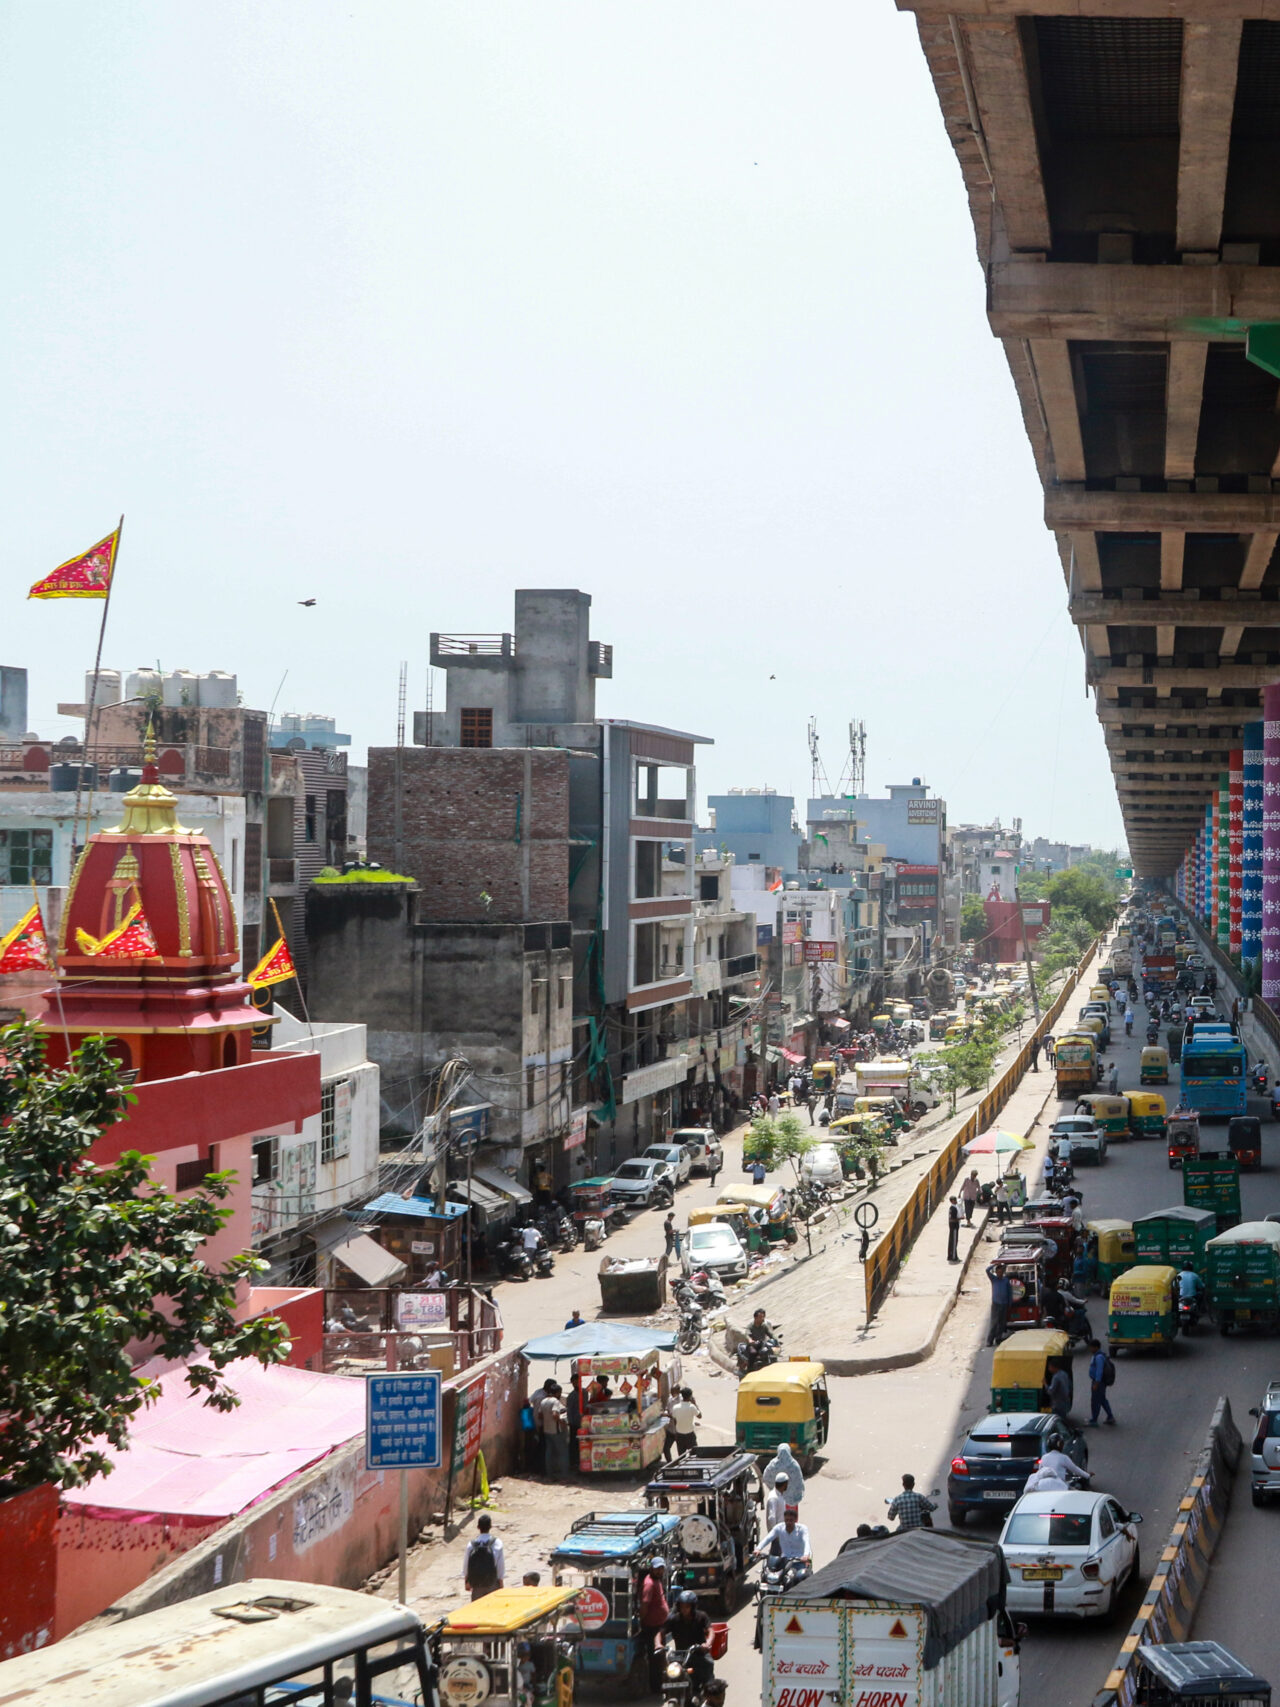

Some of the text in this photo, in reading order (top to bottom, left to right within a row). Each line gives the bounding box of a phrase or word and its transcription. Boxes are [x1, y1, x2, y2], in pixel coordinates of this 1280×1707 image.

[908, 800, 936, 809] ARVIND
[951, 874, 972, 883] CNG
[777, 1688, 908, 1707] BLOW HORN
